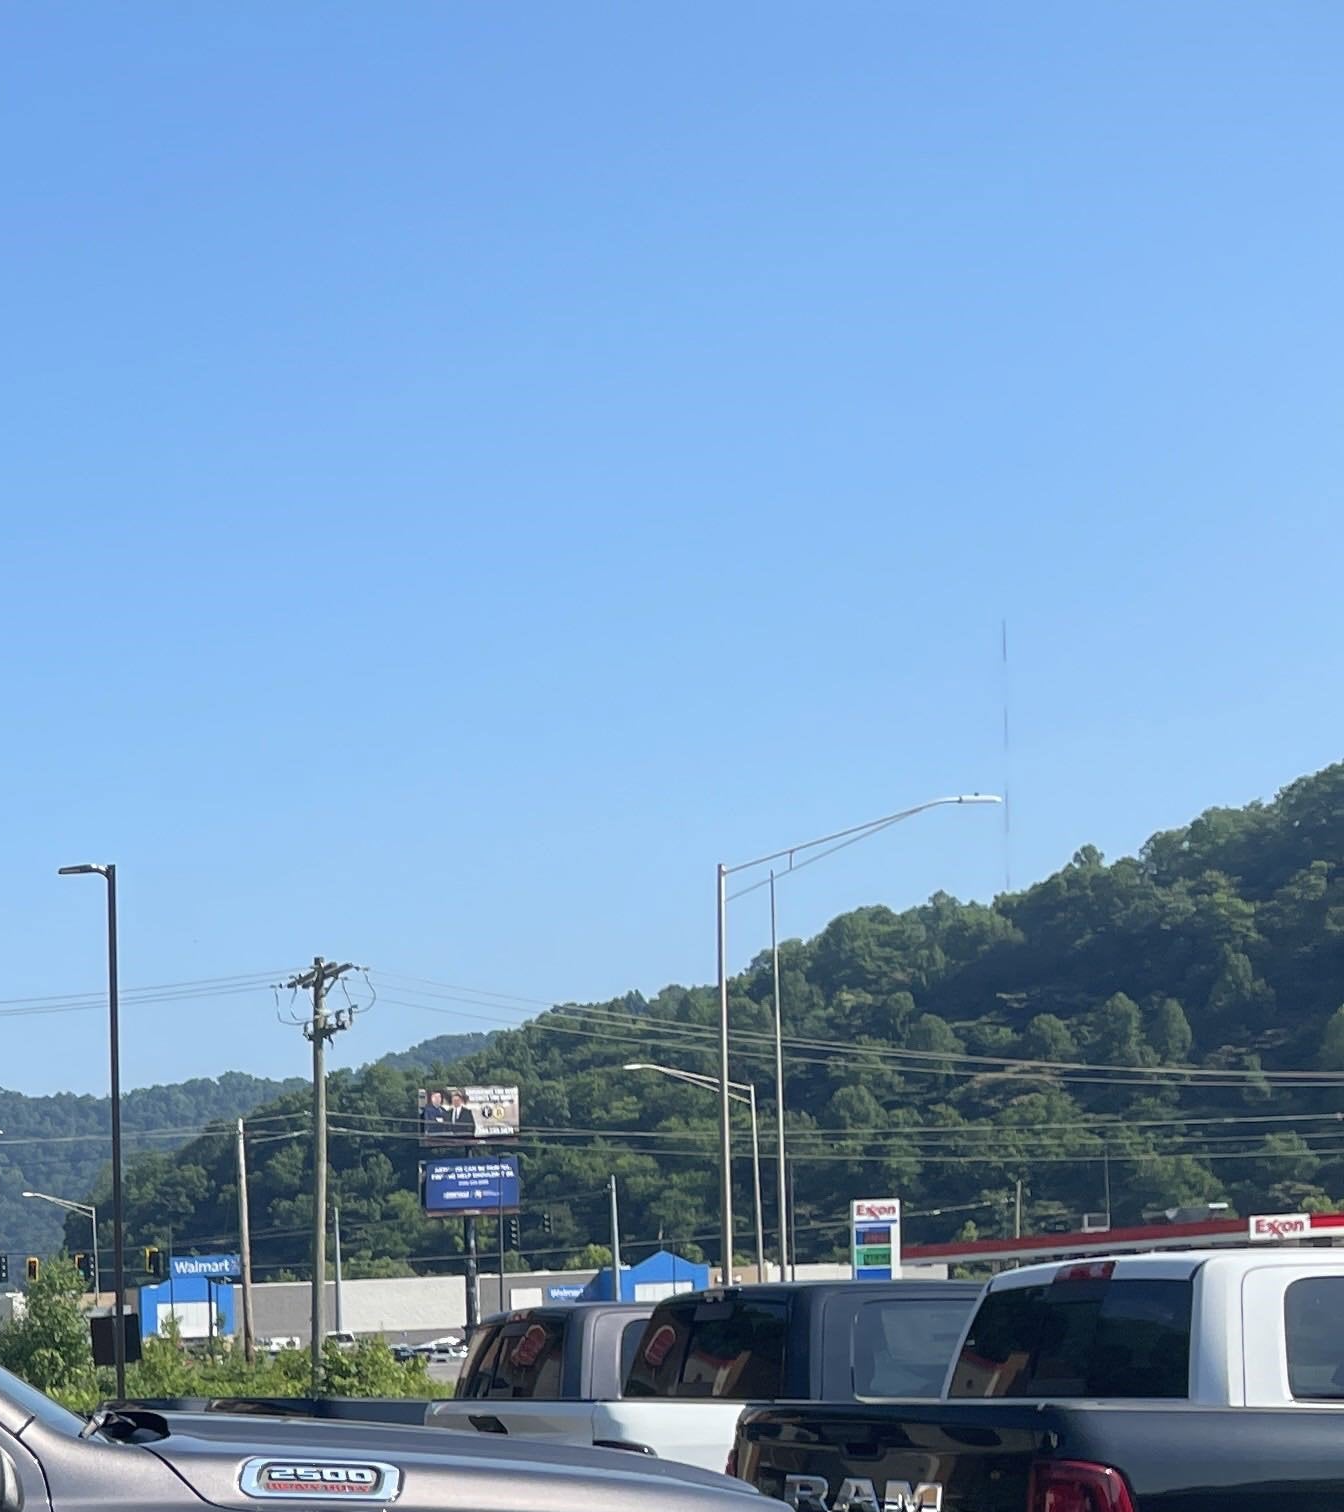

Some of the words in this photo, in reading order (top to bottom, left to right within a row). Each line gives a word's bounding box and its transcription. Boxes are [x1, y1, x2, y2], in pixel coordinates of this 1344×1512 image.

[856, 1204, 897, 1220] Exxon
[1255, 1219, 1305, 1240] Exxon
[174, 1259, 230, 1275] Walmart
[267, 1467, 372, 1483] 2500
